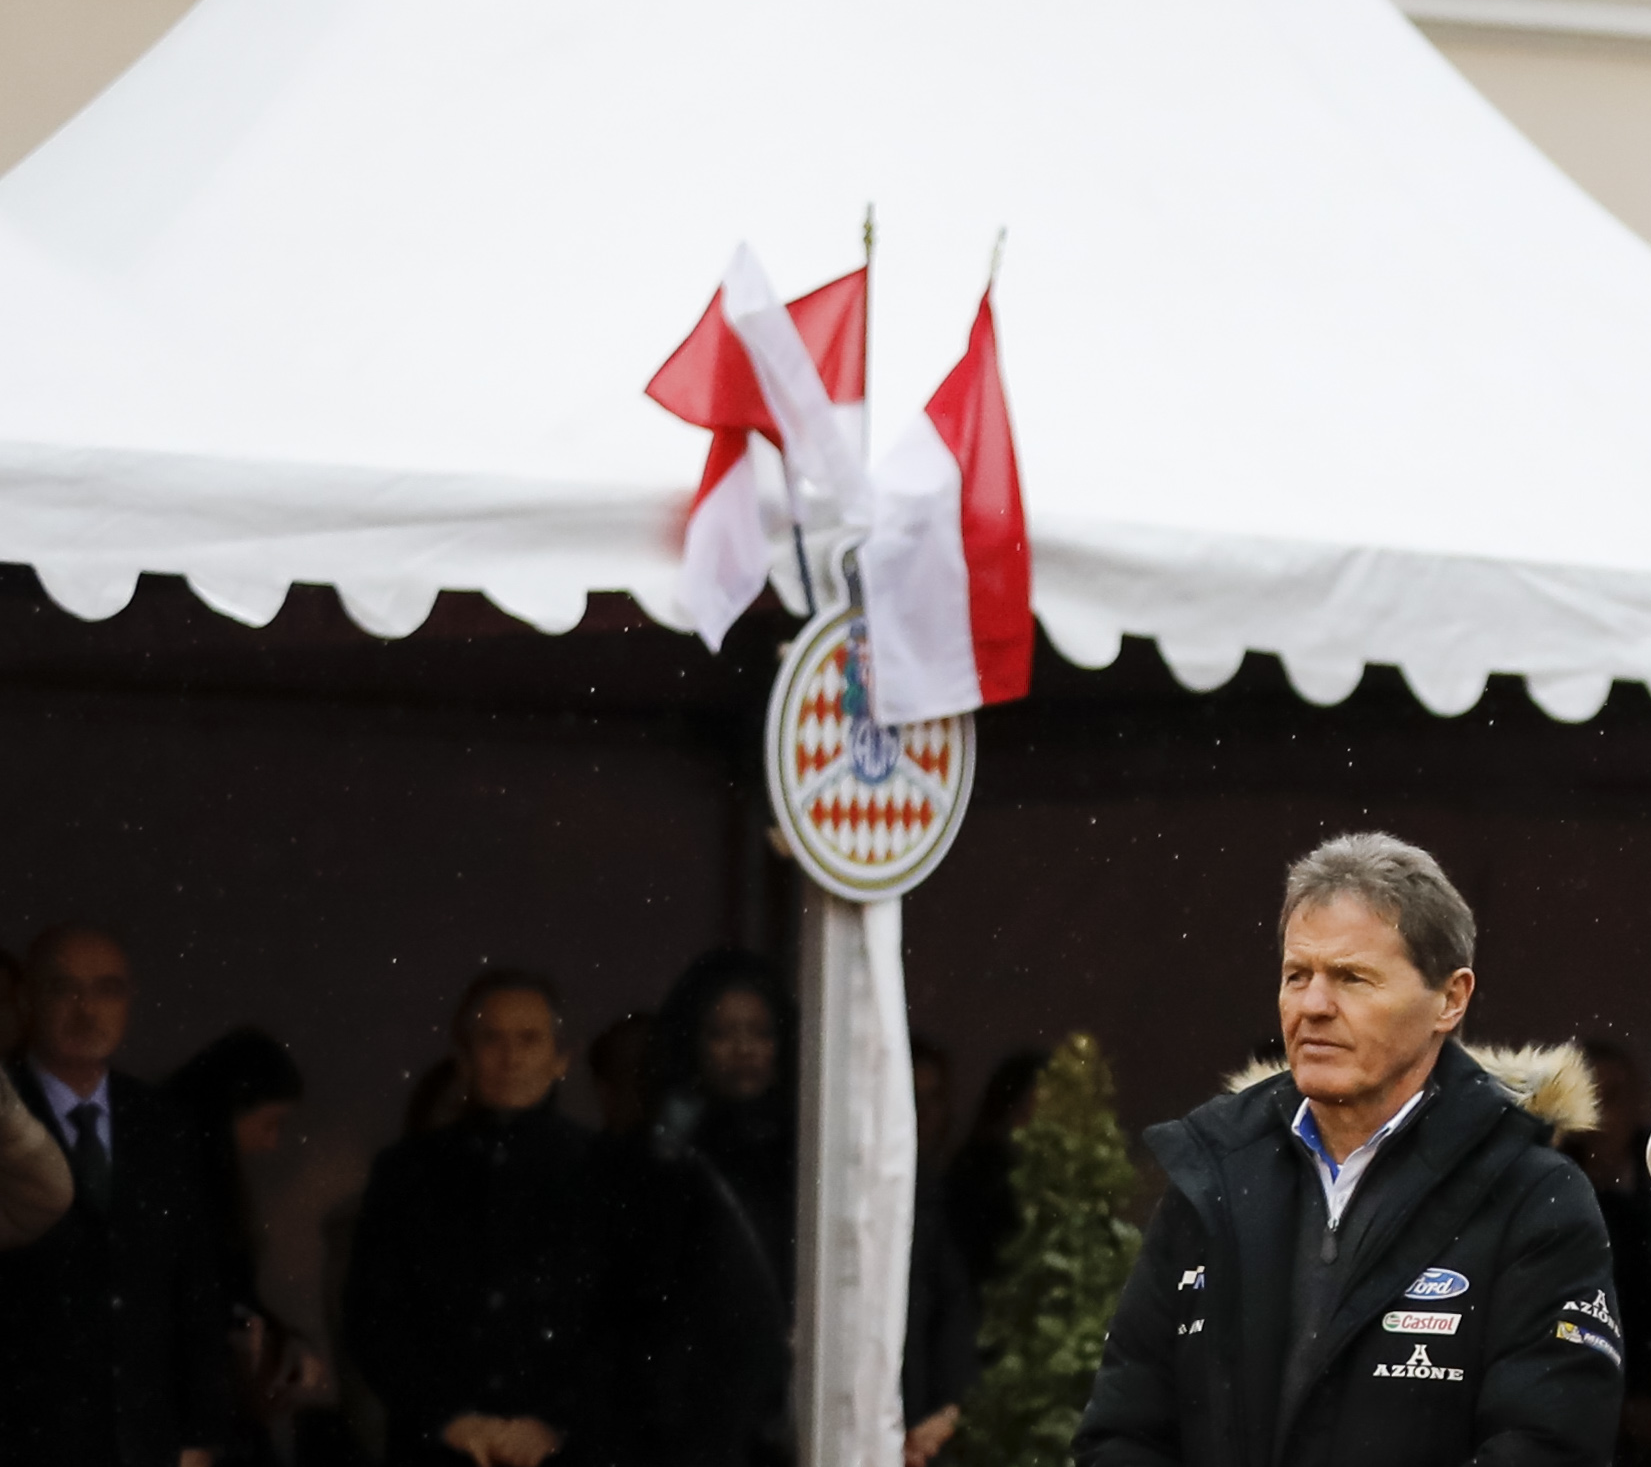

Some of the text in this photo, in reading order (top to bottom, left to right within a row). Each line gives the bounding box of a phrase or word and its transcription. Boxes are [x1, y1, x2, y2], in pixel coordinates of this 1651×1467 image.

[1407, 1270, 1453, 1296] Ford
[1401, 1314, 1460, 1333] Castrol
[1373, 1364, 1464, 1381] AZIONE
